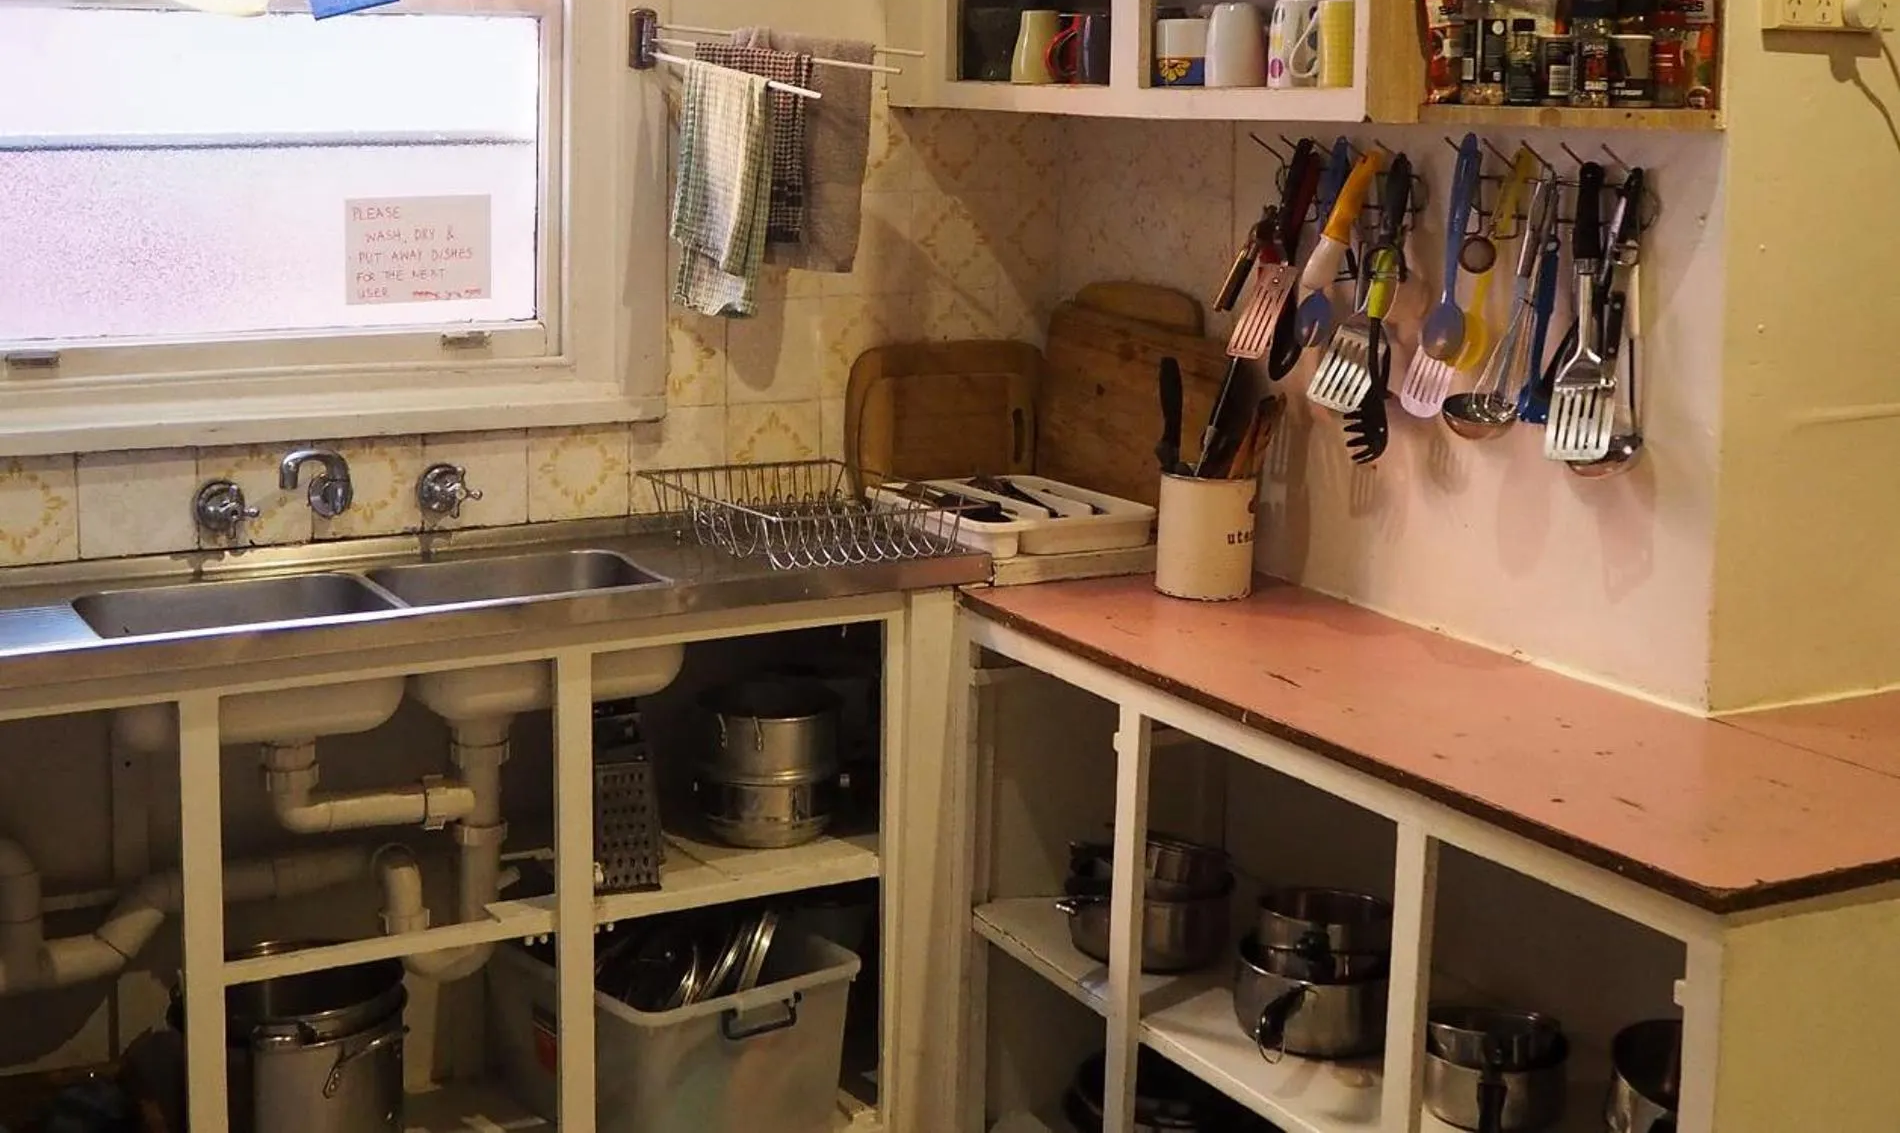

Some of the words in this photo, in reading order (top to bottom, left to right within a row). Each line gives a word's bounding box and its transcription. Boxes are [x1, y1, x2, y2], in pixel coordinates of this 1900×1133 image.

[352, 206, 401, 221] PLEASE
[414, 228, 436, 241] DRY
[358, 252, 382, 264] PUT
[391, 249, 423, 262] AWAY
[432, 247, 474, 262] DISHES
[356, 271, 376, 284] FOR
[383, 268, 405, 281] THE
